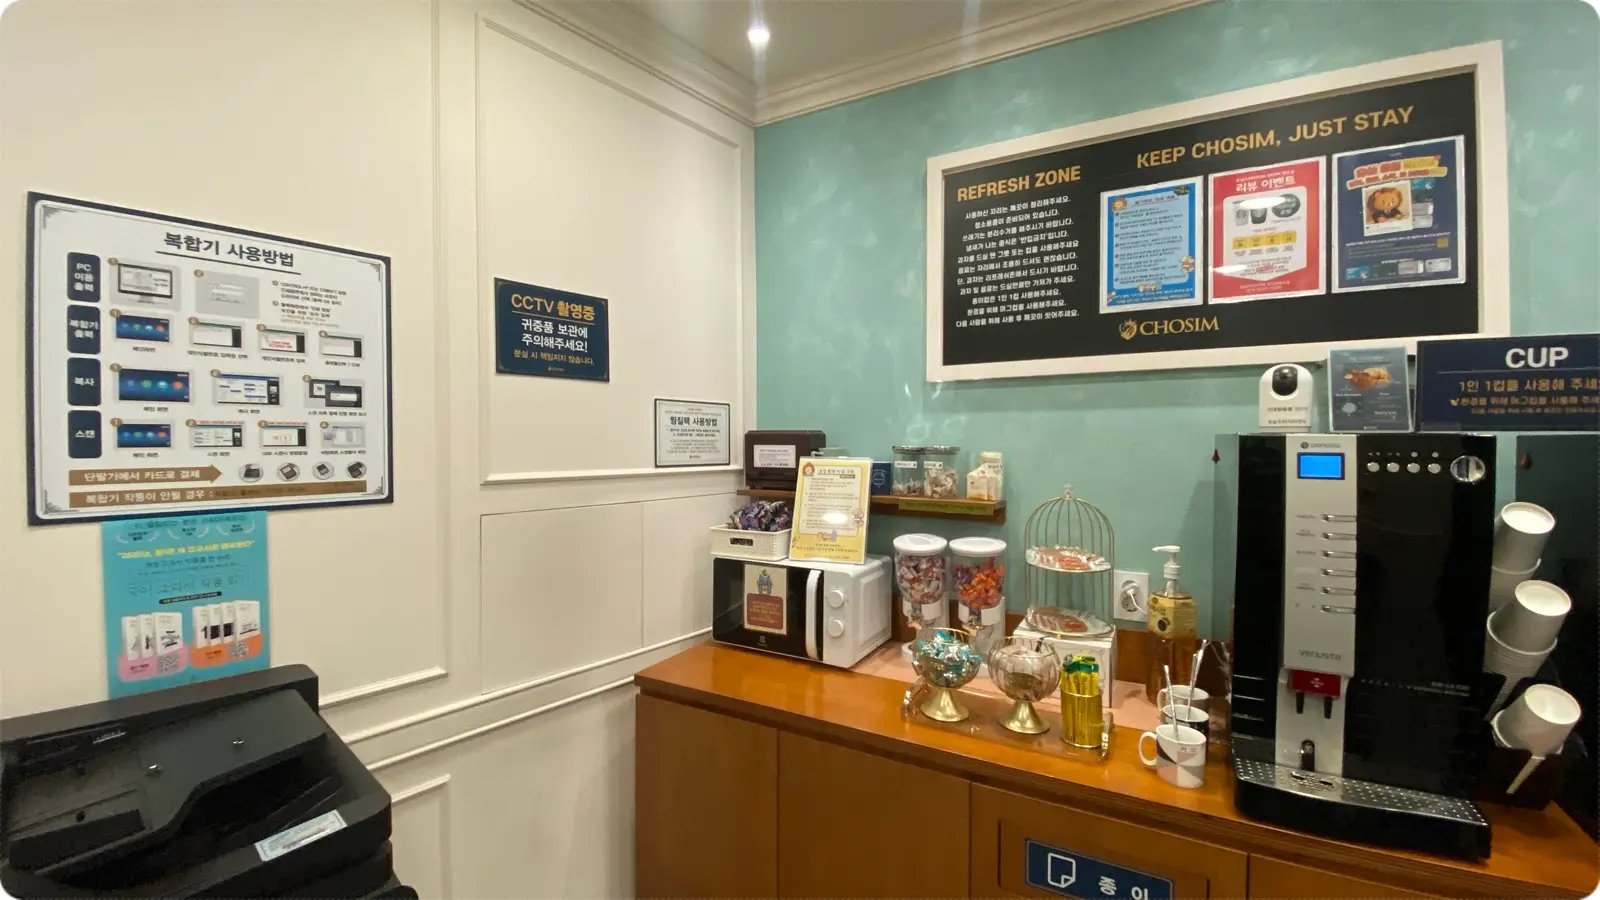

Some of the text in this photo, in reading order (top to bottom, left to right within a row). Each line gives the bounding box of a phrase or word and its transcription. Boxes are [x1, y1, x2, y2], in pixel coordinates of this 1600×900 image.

[1137, 106, 1415, 169] KEEP CHOSIM, JUST STAY
[958, 166, 1081, 201] REFRESH ZONE
[1236, 183, 1257, 193] 리뷰
[1261, 176, 1296, 188] 이벤트
[965, 196, 1071, 219] 사용하신 자리는 깨끗이 정리해주세요.
[975, 209, 1060, 229] 청소용품이 준비되어 있습니다.
[962, 218, 1074, 242] 쓰레기는 분리수거를 해주시기 바랍니다.
[164, 233, 294, 268] 복합기 사용방법
[958, 254, 975, 263] 과자를
[976, 252, 988, 262] 드실
[998, 250, 1010, 259] 그릇
[1011, 248, 1024, 256] 또는
[1026, 246, 1038, 254] 컵을
[966, 244, 984, 252] 냄새가
[999, 239, 1017, 247] 음식은
[76, 263, 91, 272] PC
[958, 266, 975, 275] 음료는
[977, 263, 1001, 272] 자리에서
[1003, 260, 1021, 269] 조용히
[1043, 252, 1078, 263] 괜찮습니다.
[967, 275, 984, 284] 과자는
[1030, 268, 1049, 276] 드시기
[1051, 264, 1079, 273] 바랍니다.
[960, 275, 1075, 295] 과자 및 음료는 드실만큼만 가져가 주세요.
[972, 289, 1061, 305] 종이컵은 1인 1컵 사용해주세요.
[511, 293, 596, 321] CCTV 촬영중
[967, 300, 1067, 316] 환경을 위해 머그컵을 사용해주세요.
[70, 319, 99, 330] 복합기
[956, 320, 967, 328] 다음
[988, 317, 1000, 325] 위해
[1002, 315, 1014, 323] 사용
[1016, 314, 1022, 322] 후
[1024, 312, 1043, 321] 깨끗이
[1044, 309, 1080, 319] 씻어주세요.
[1140, 316, 1220, 336] CHOSIM
[75, 329, 93, 339] 출력
[522, 319, 588, 338] 귀중품 보관에
[522, 333, 588, 353] 주의해주세요!
[514, 349, 528, 359] 분실
[531, 352, 538, 360] 시
[569, 355, 595, 366] 않습니다.
[1505, 347, 1569, 368] CUP
[74, 377, 94, 387] 복사
[1459, 378, 1600, 392] 1인 1컵을 사용해 주세
[670, 416, 718, 427] 찜질팩 사용방법
[75, 429, 95, 439] 스캔
[84, 469, 200, 482] 단말기에서 카드로 결제
[85, 493, 121, 505] 복합기
[125, 492, 157, 503] 작동이
[161, 490, 184, 501] 안될
[188, 489, 206, 500] 경우
